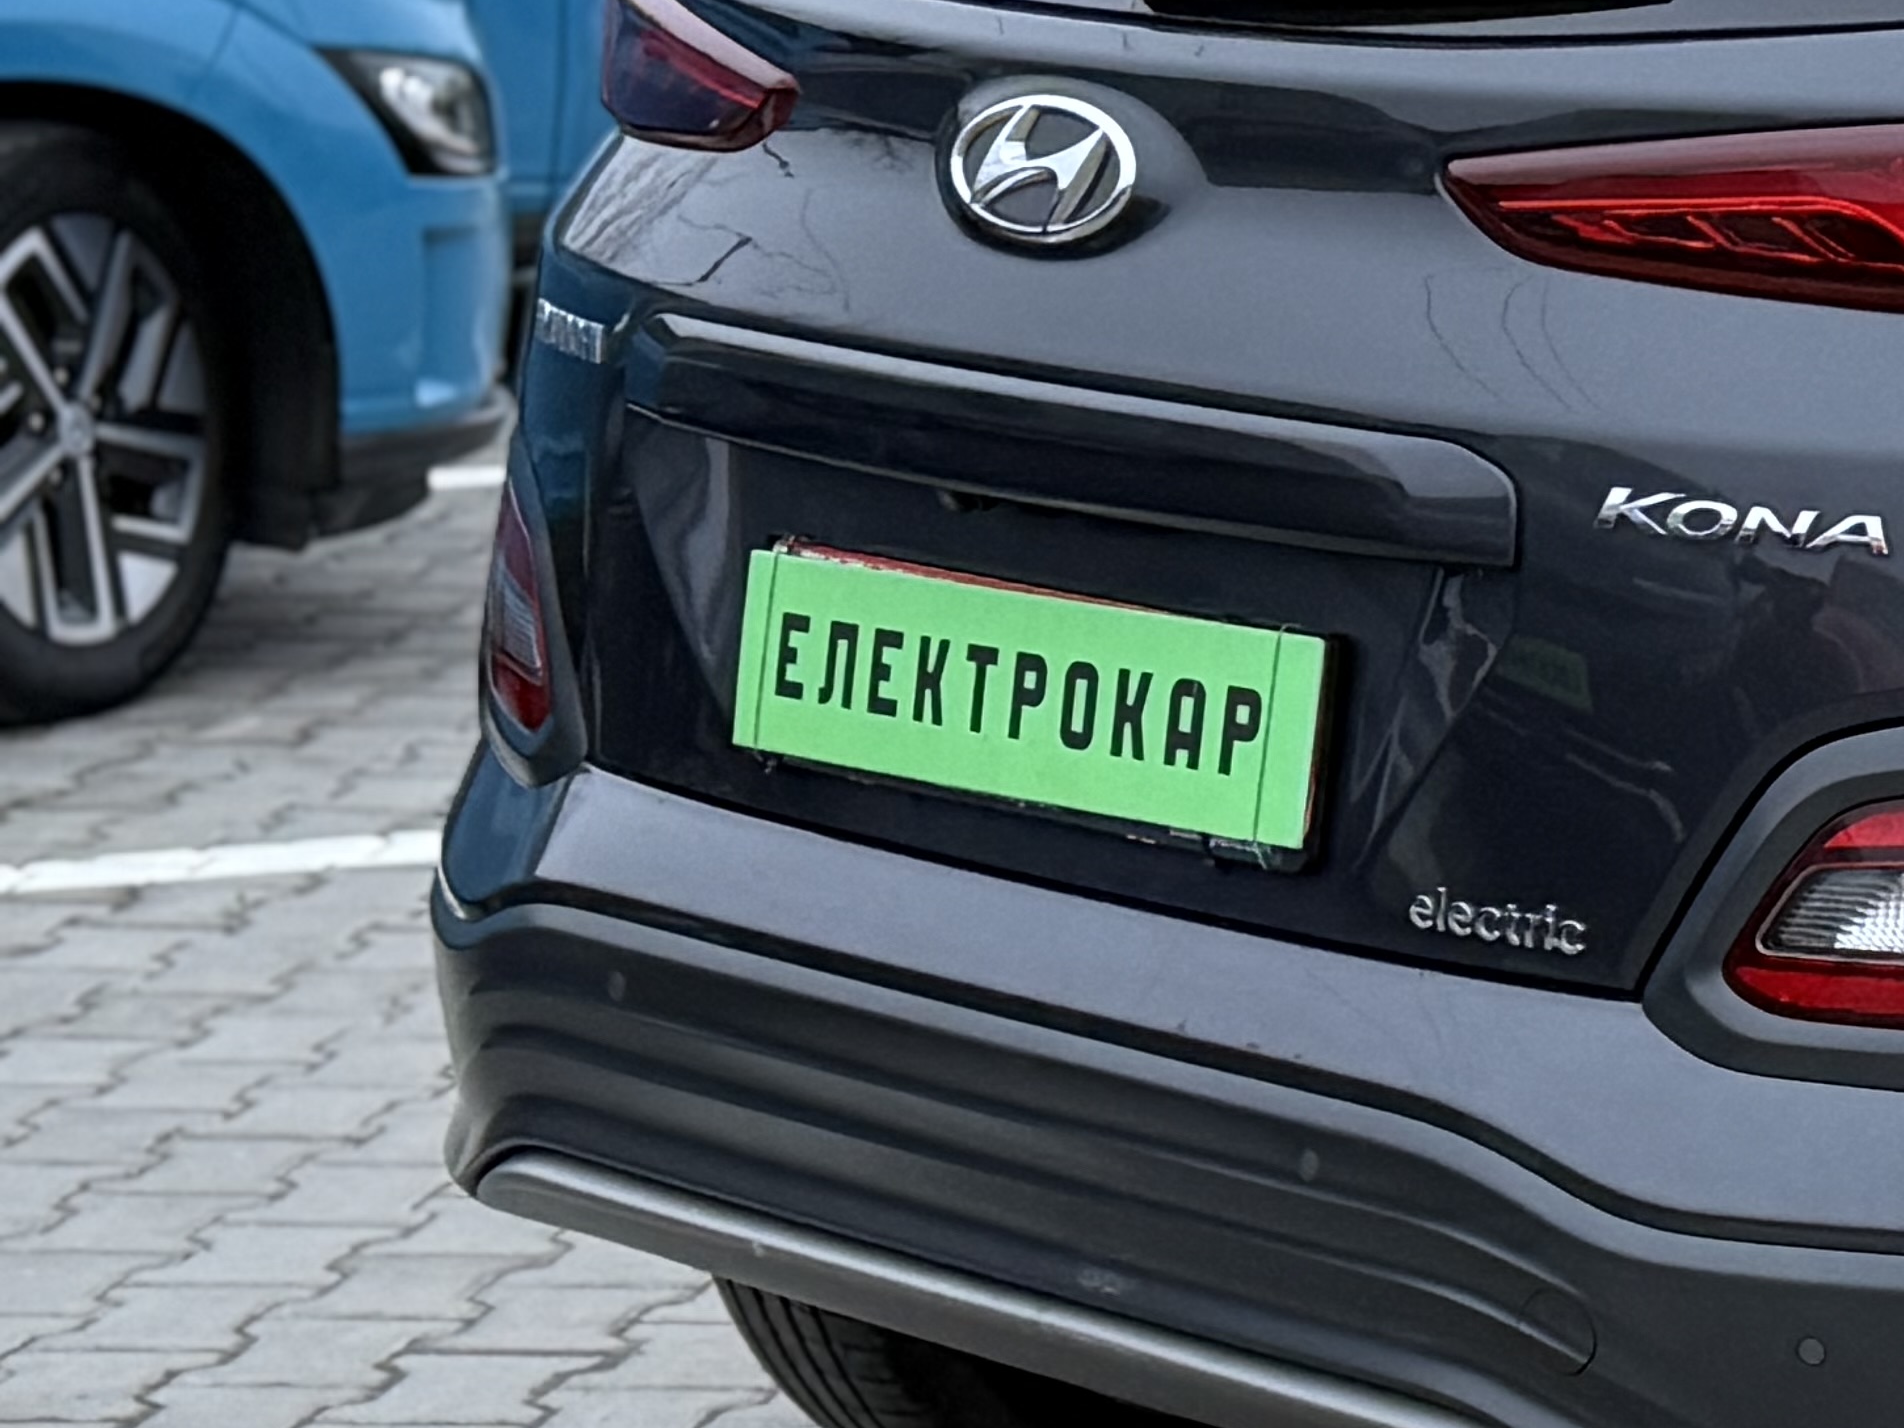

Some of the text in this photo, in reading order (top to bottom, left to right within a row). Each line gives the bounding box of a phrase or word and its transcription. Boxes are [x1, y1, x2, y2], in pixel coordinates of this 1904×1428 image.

[1594, 487, 1889, 555] KONA
[774, 611, 1263, 776] ЕЛЕКТРОКАР
[1409, 886, 1586, 955] electric
